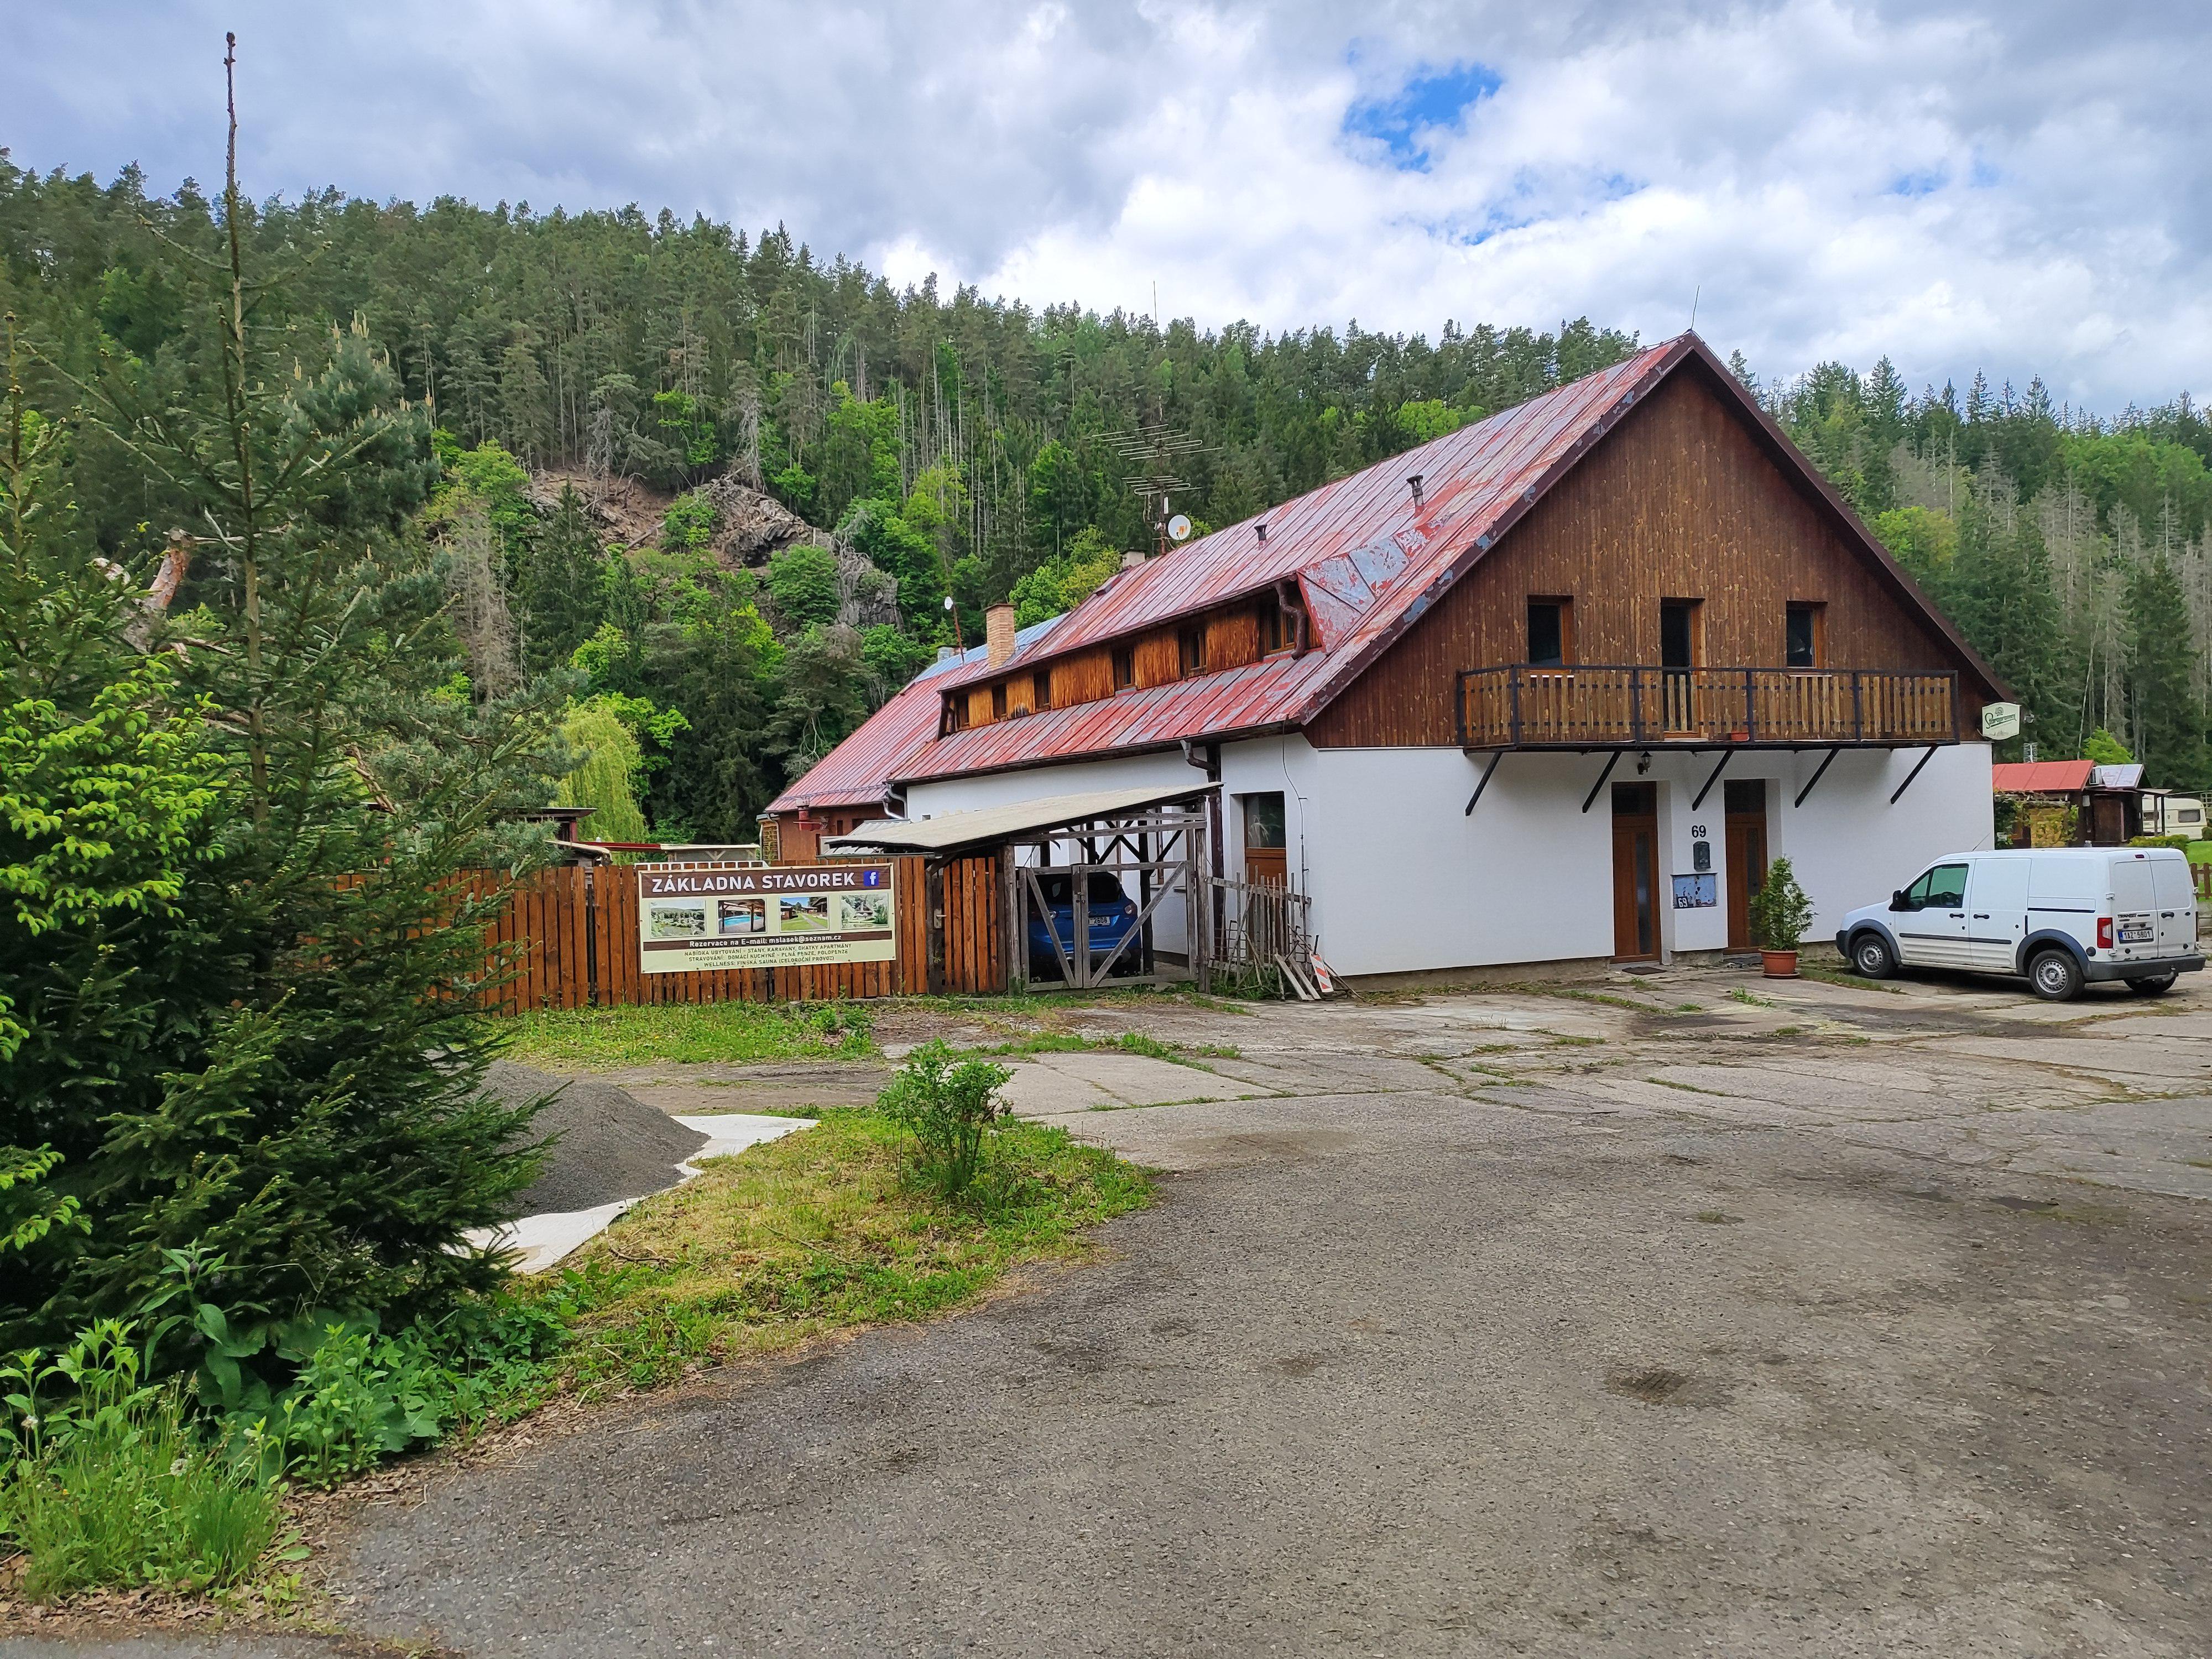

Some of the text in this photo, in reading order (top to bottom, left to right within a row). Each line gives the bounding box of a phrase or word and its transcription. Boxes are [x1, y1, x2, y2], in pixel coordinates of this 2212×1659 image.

[1691, 825, 1707, 838] 69
[651, 872, 855, 893] ZÁKLADNA STAVOREK
[1677, 898, 1688, 907] 69
